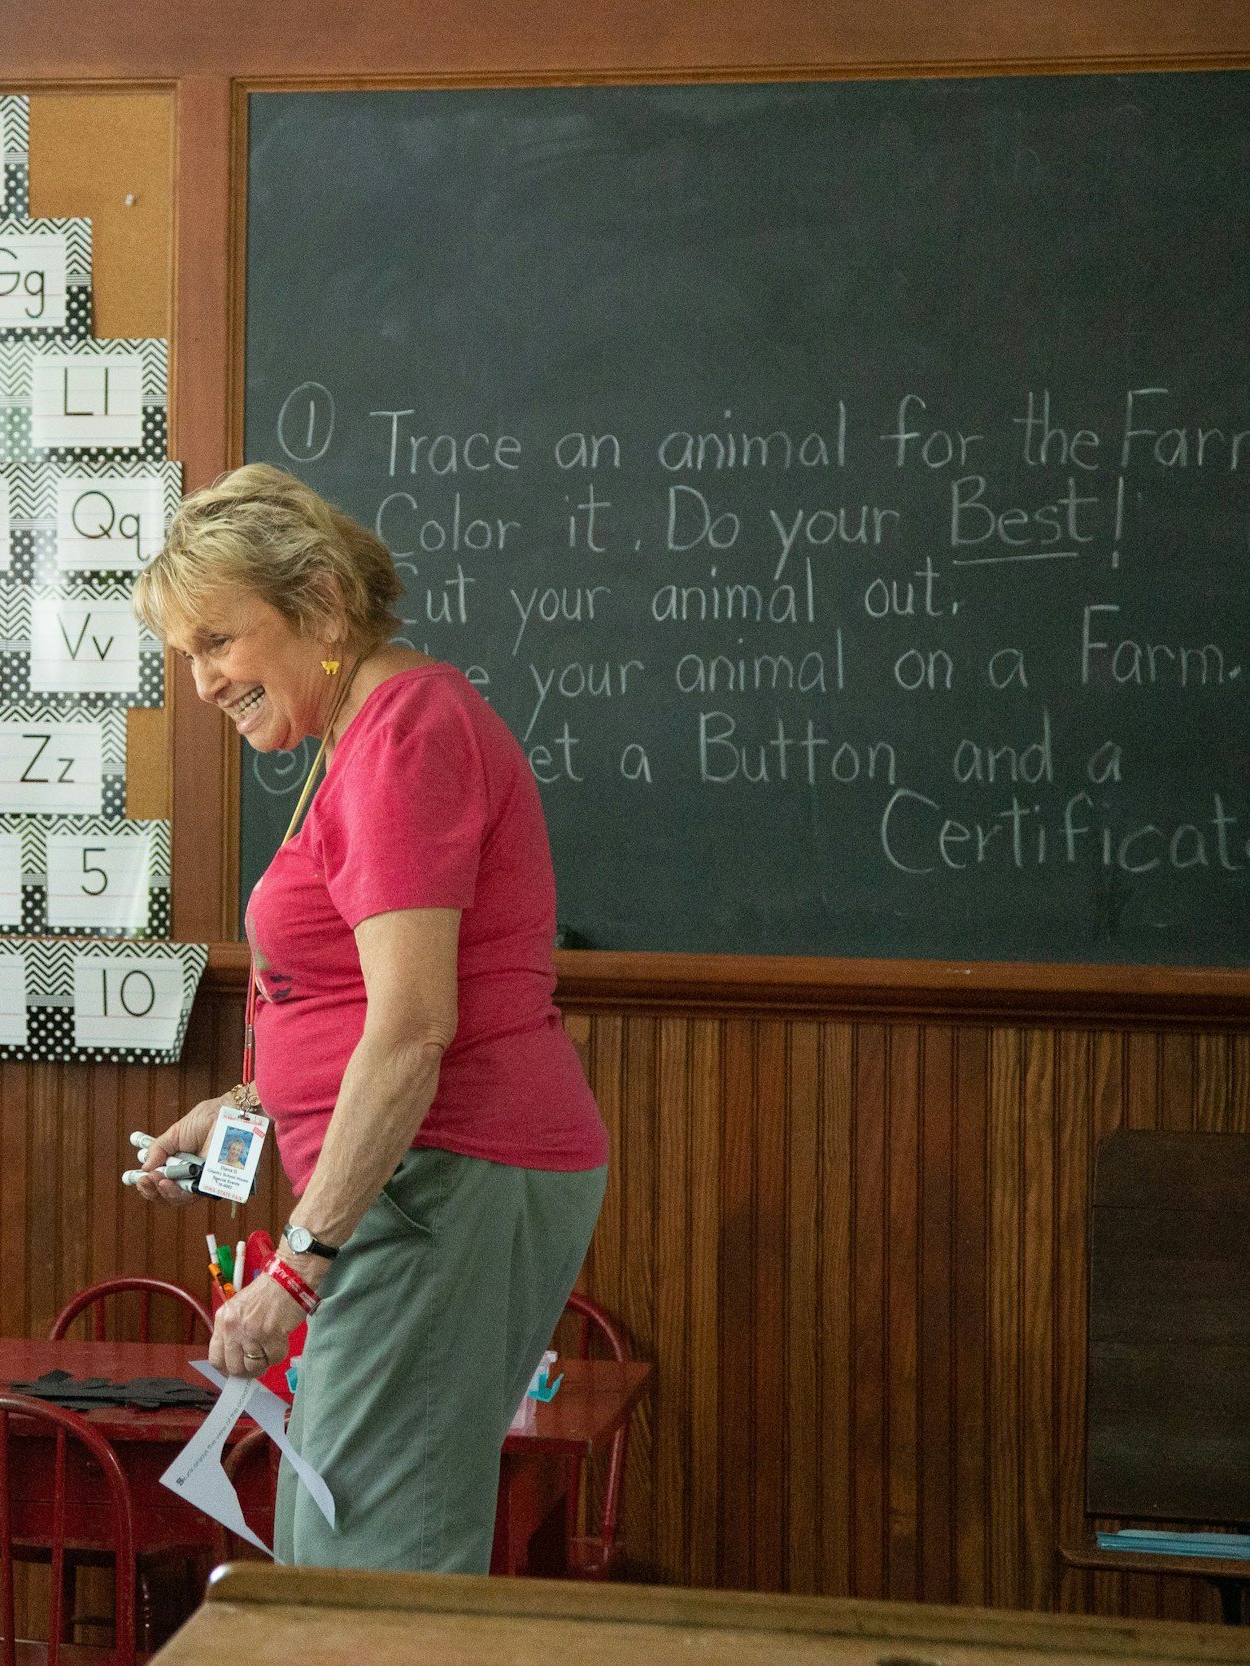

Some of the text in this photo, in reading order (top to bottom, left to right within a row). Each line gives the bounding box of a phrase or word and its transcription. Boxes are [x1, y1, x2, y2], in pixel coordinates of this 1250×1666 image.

[369, 409, 522, 476] Trace
[556, 433, 620, 469] an
[658, 397, 847, 472] animal
[880, 394, 984, 468] for
[1013, 389, 1100, 470] the
[70, 489, 150, 562] Qq
[375, 492, 522, 557] Color
[667, 485, 741, 551] Do
[770, 505, 900, 581] your
[55, 612, 115, 661] Vv
[510, 586, 611, 655] your
[651, 555, 813, 623] animal
[524, 659, 645, 742] your
[675, 627, 844, 695] animal
[894, 649, 952, 690] on
[988, 649, 1028, 689] a
[1081, 604, 1242, 687] Farm.
[19, 734, 76, 784] Zz
[620, 743, 652, 783] a
[698, 711, 896, 786] Button
[953, 706, 1051, 784] and
[1086, 741, 1122, 784] a
[880, 788, 1250, 875] Certificat
[80, 848, 108, 896] 5
[100, 969, 155, 1018] 10
